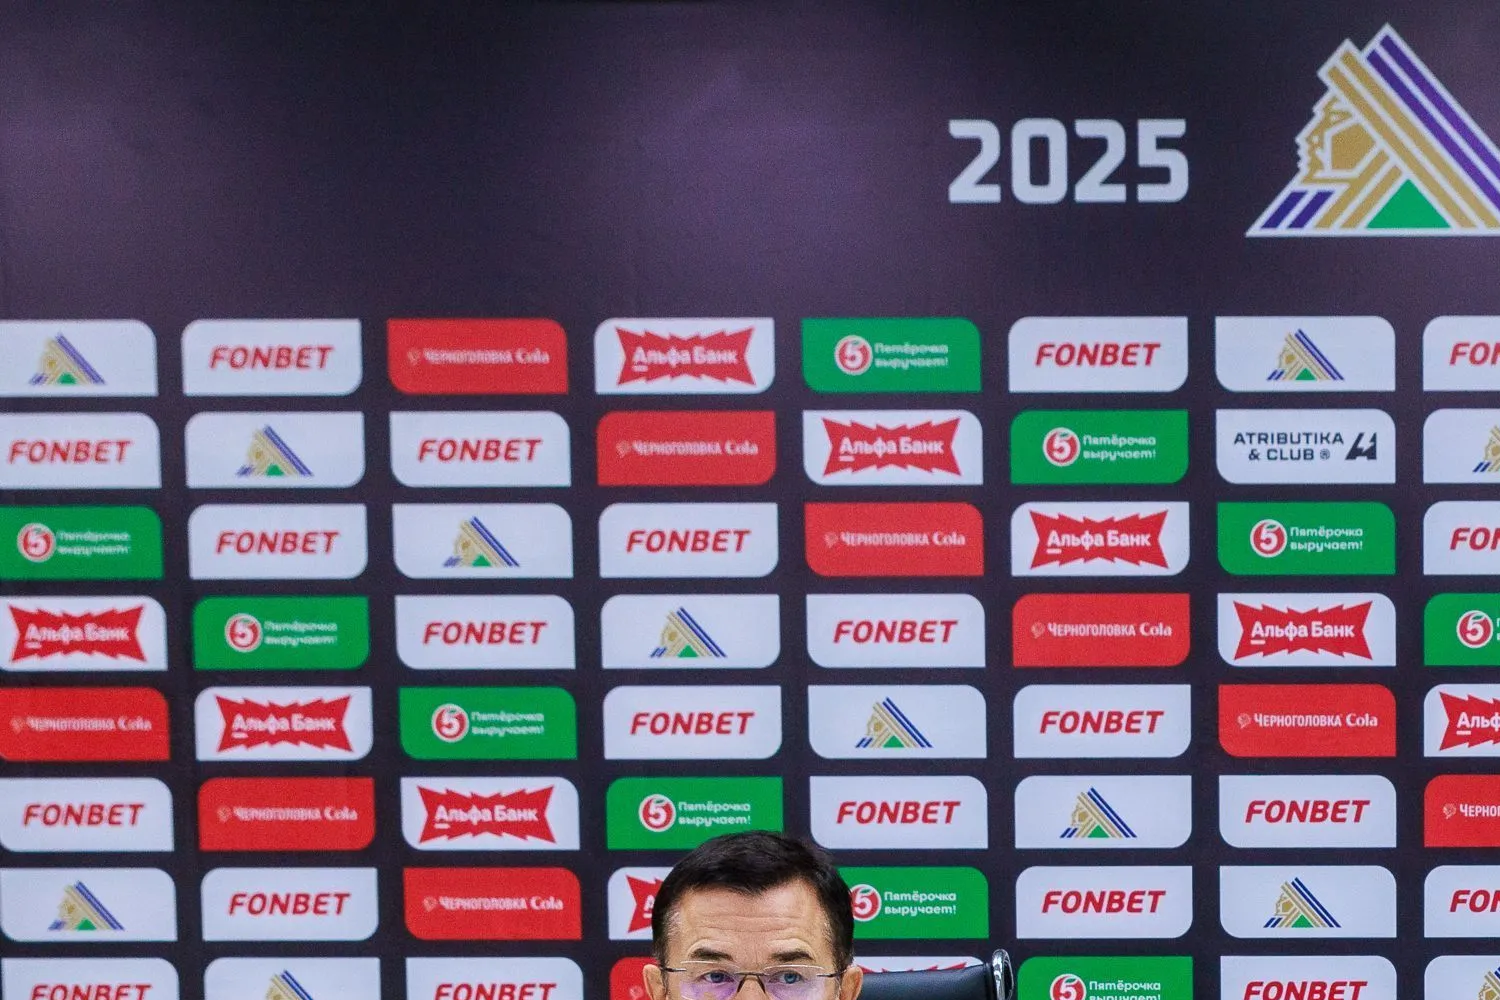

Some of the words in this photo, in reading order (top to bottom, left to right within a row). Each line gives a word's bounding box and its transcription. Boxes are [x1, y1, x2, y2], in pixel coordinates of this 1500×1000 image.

[948, 117, 1189, 205] 2025
[210, 346, 333, 369] FONBET
[633, 346, 691, 370] Альфа
[693, 347, 737, 364] Банк
[1036, 343, 1160, 366] FONBET
[1234, 433, 1343, 444] ATRIBUTIKA
[9, 440, 130, 463] FONBET
[418, 439, 541, 461] FONBET
[1267, 449, 1314, 460] CLUB
[217, 532, 338, 554] FONBET
[627, 530, 750, 552] FONBET
[1047, 529, 1104, 552] Альфа
[1107, 530, 1150, 546] Банк
[1290, 526, 1363, 539] Пятёрочка
[1290, 540, 1362, 552] выручает!
[424, 622, 546, 644] FONBET
[834, 621, 957, 643] FONBET
[1139, 623, 1172, 636] Cola
[1251, 620, 1308, 643] Альфа
[1311, 621, 1354, 637] Банк
[631, 712, 754, 735] FONBET
[1040, 711, 1164, 733] FONBET
[1345, 713, 1377, 727] Cola
[24, 804, 144, 826] FONBET
[678, 801, 751, 813] Пятёрочка
[837, 801, 960, 824] FONBET
[1246, 800, 1370, 823] FONBET
[678, 815, 750, 827] выручает!
[230, 893, 350, 915] FONBET
[884, 891, 956, 903] Пятёрочка
[1042, 891, 1166, 913] FONBET
[884, 904, 955, 916] выручает!
[1089, 980, 1161, 992] Пятёрочка
